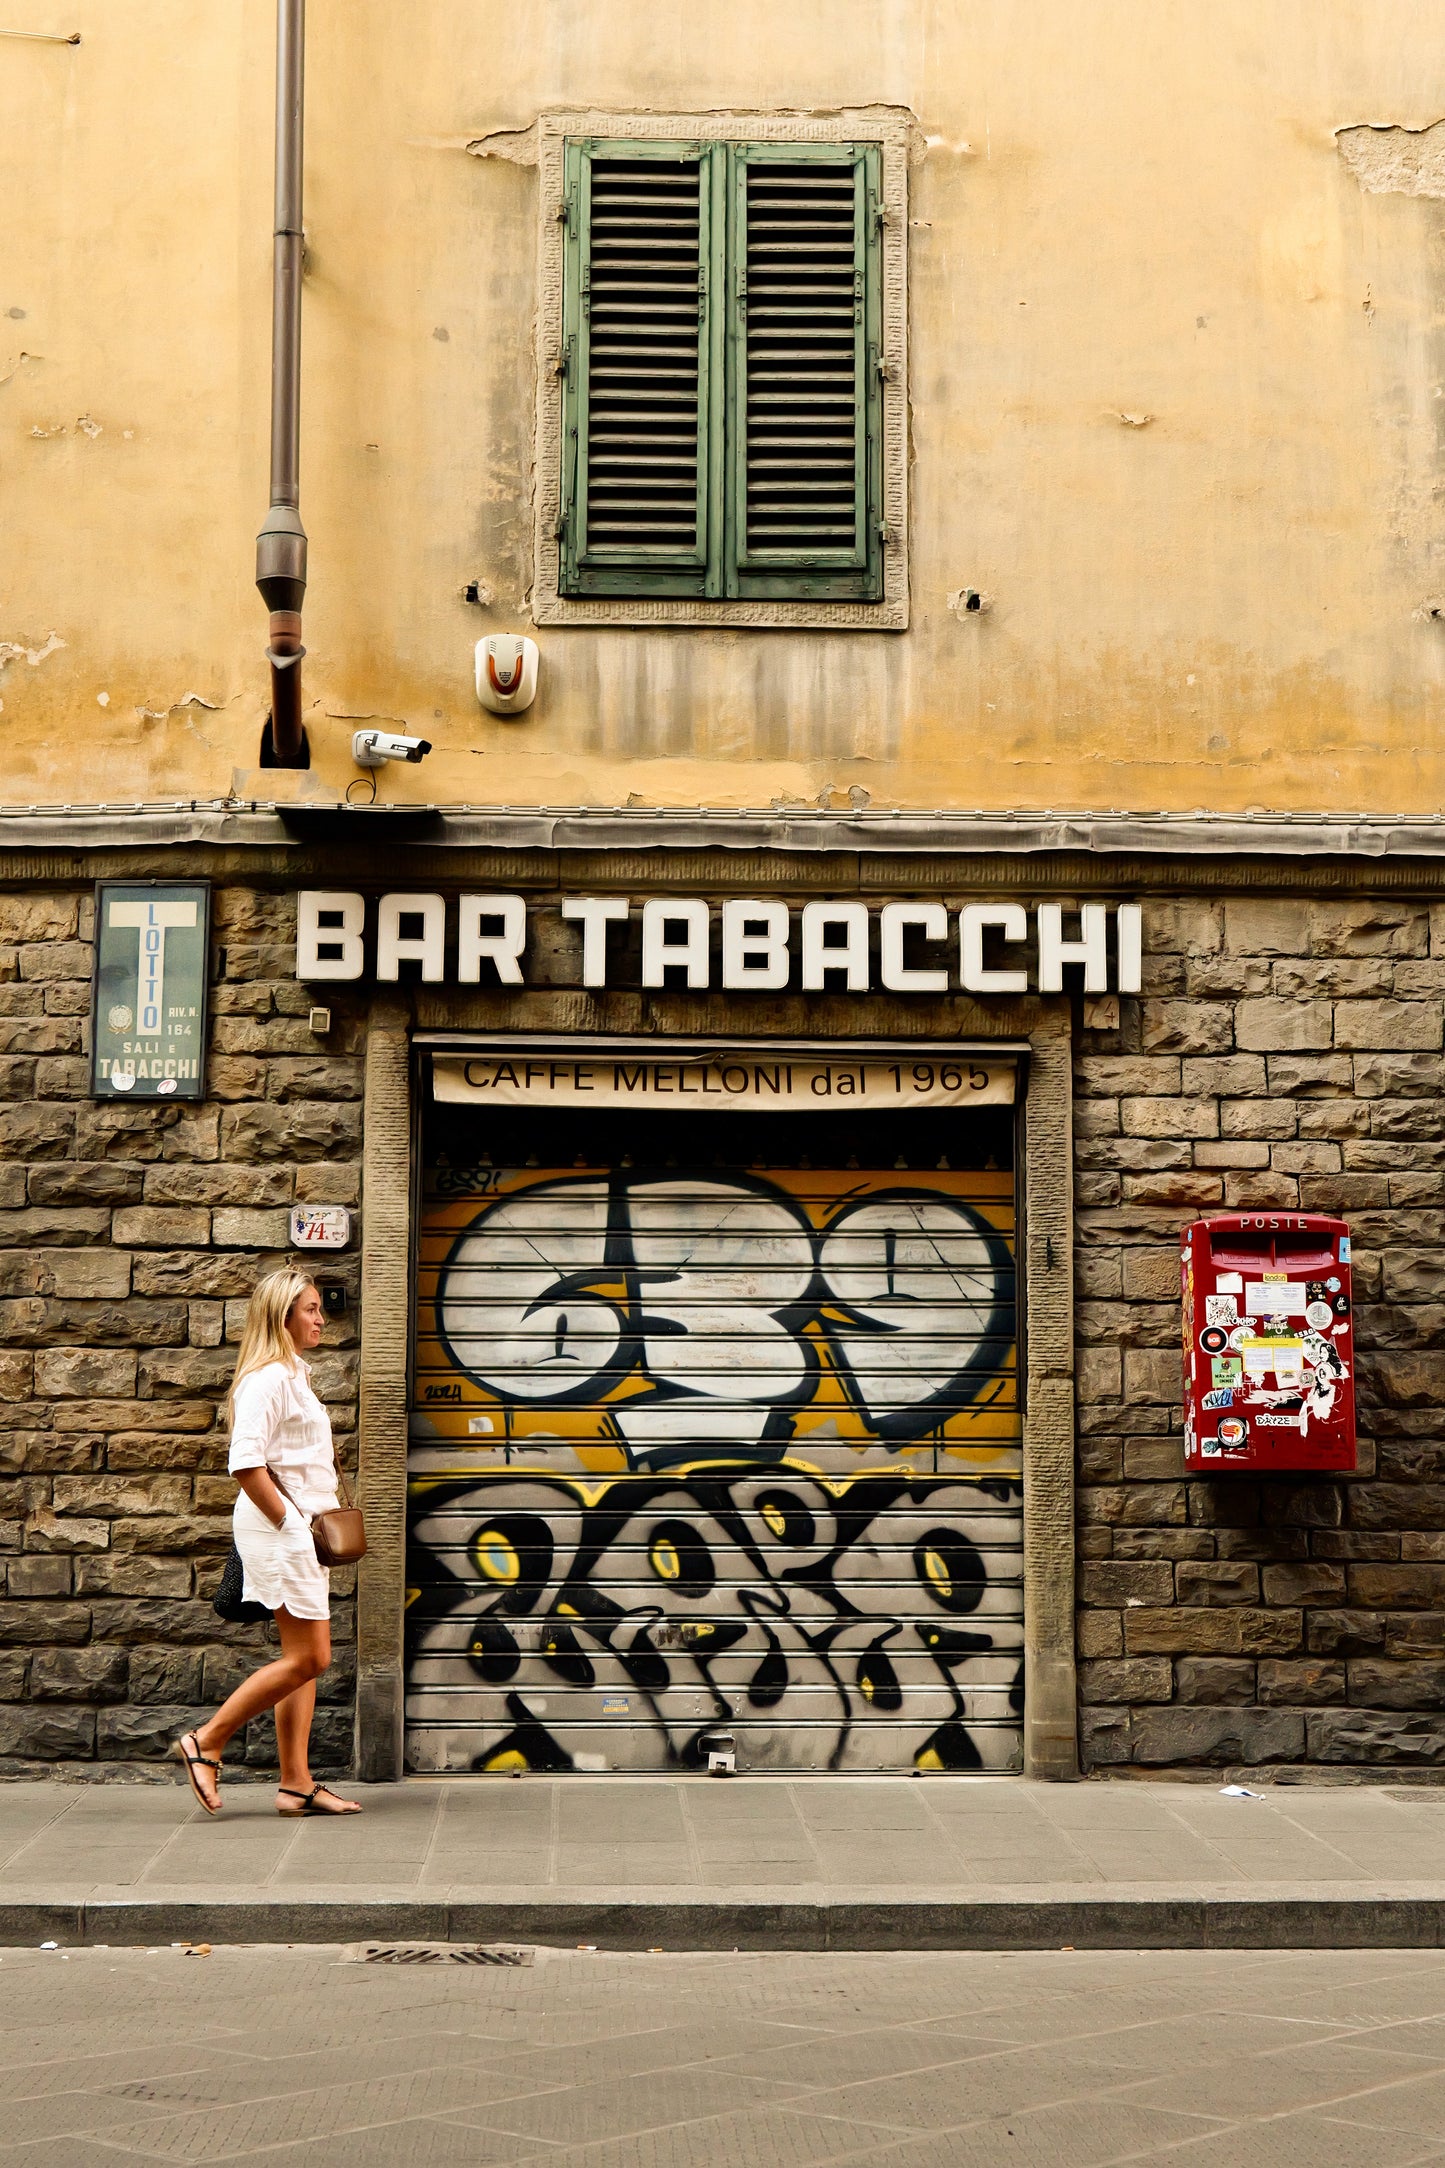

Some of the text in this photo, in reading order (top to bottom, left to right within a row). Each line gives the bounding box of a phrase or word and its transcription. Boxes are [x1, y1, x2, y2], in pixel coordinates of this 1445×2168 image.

[297, 890, 1142, 993] BAR TABACCHI
[144, 904, 159, 1028] LOTTO
[167, 1024, 192, 1036] 164
[123, 1042, 175, 1054] SALI E
[100, 1058, 197, 1079] TABACCHI
[463, 1061, 990, 1096] CAFFE MELLONI dal 1965
[1240, 1217, 1308, 1229] POSTE
[424, 1384, 463, 1402] 2024
